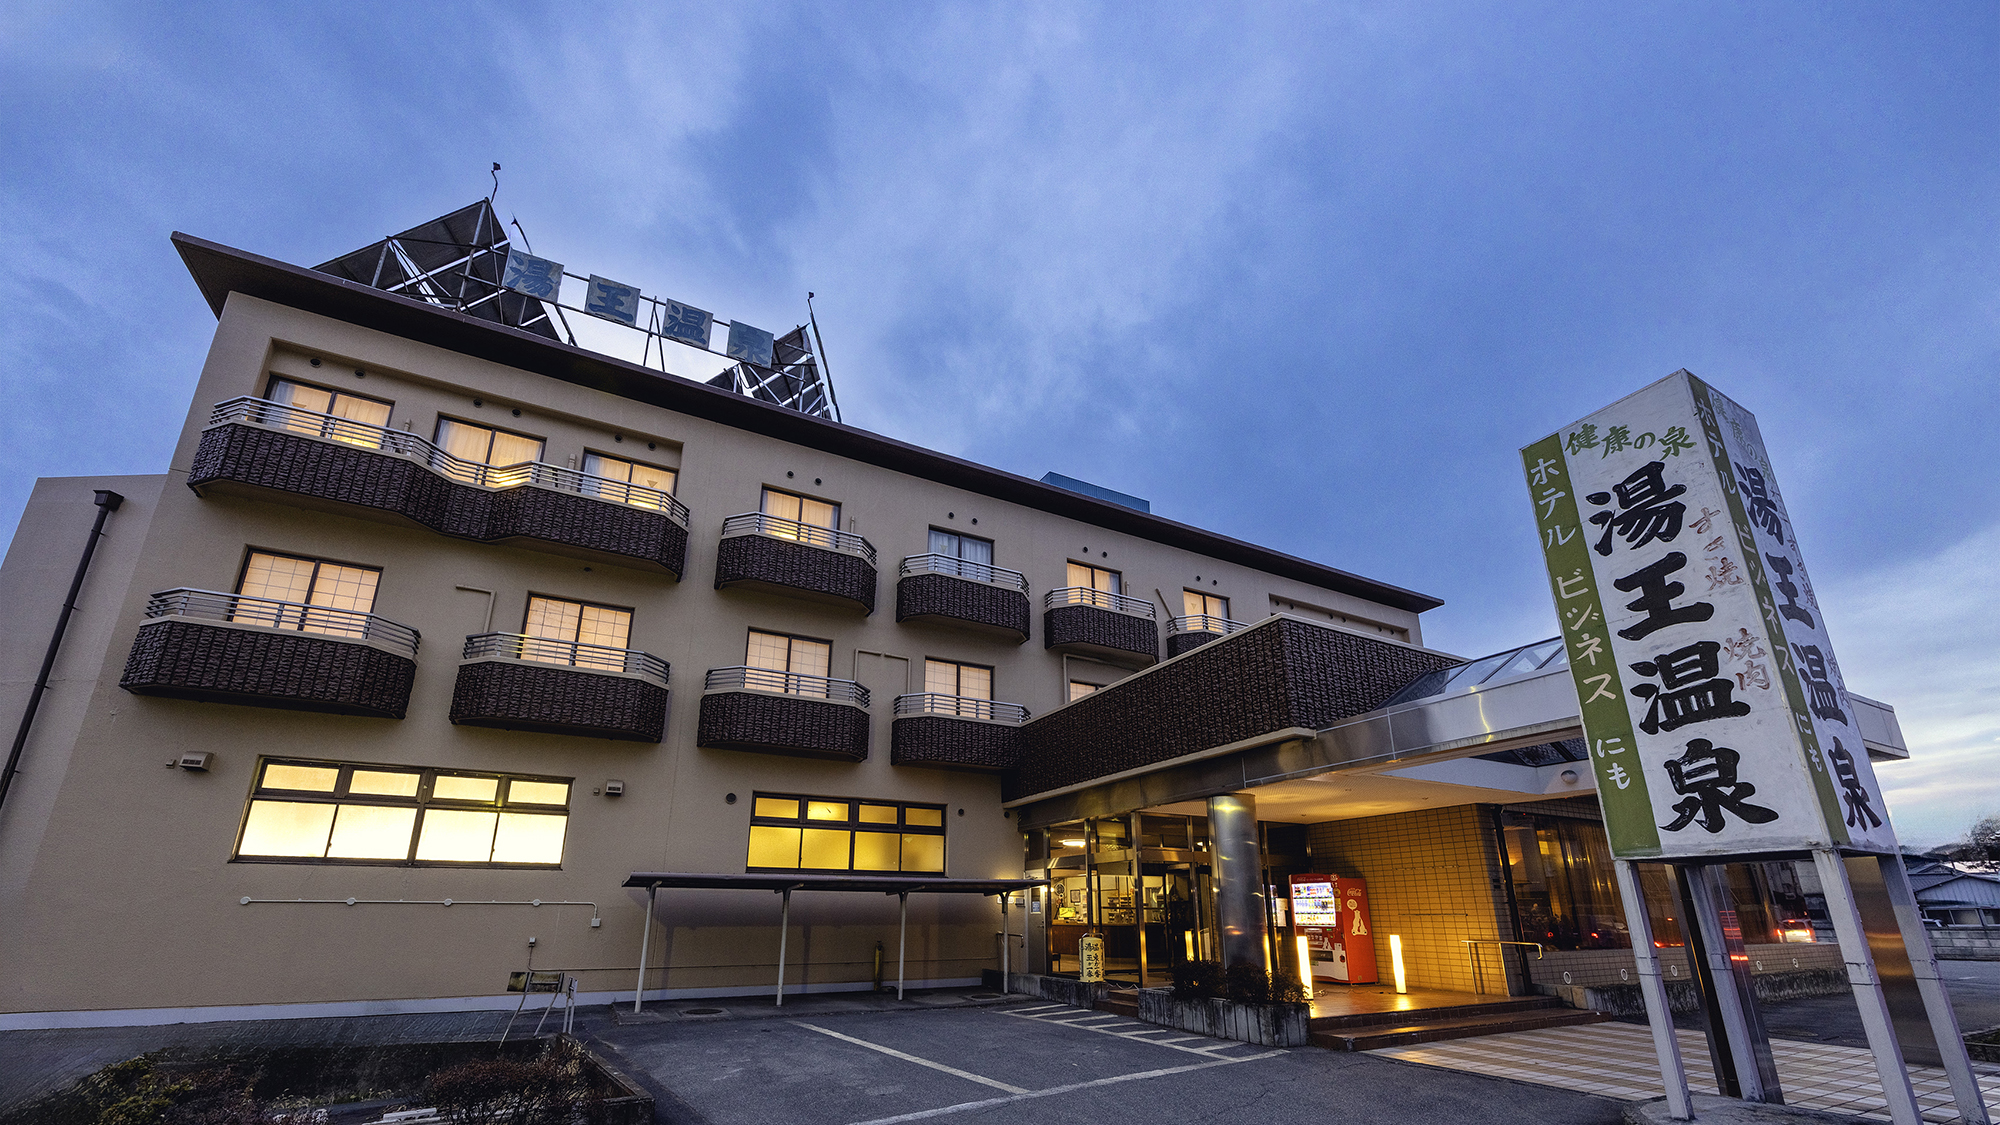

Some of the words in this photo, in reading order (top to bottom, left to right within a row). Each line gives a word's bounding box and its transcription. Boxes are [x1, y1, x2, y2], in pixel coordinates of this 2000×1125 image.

[504, 254, 769, 366] 湯王温泉
[1564, 422, 1697, 461] 健康の泉
[1529, 457, 1576, 551] ホテル
[1555, 570, 1617, 704] ビジネス
[1596, 736, 1631, 791] にも
[1585, 460, 1780, 834] 湯王温泉
[1696, 397, 1736, 495] ホテル
[1736, 522, 1795, 676] ビジネス
[1798, 712, 1823, 774] にも
[1734, 461, 1883, 832] 湯王温泉
